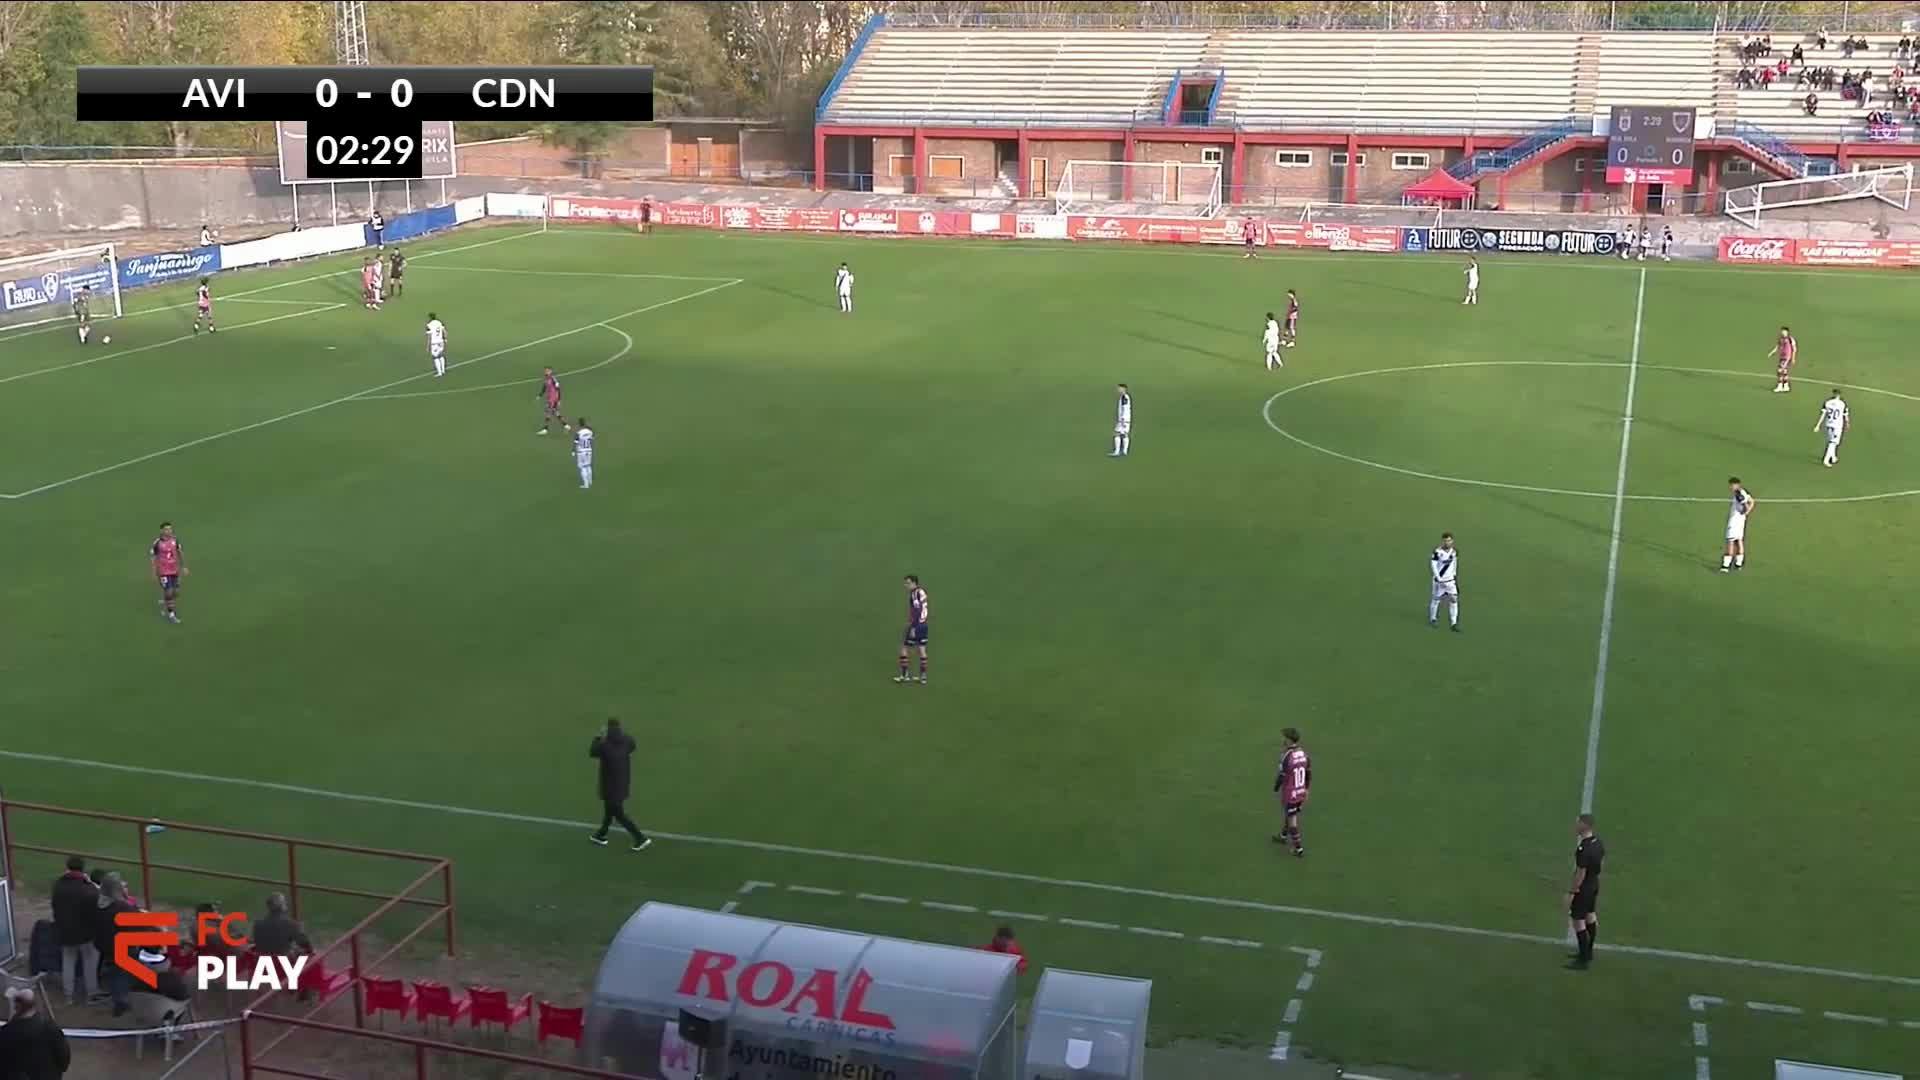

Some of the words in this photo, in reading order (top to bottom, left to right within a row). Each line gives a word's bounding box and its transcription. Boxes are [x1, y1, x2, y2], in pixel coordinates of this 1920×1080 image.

[1617, 147, 1628, 163] 0
[1672, 149, 1683, 165] 0
[1499, 231, 1544, 245] SEGUNDA
[1293, 766, 1306, 788] 10
[676, 948, 897, 1030] ROAL
[785, 1016, 896, 1047] CARNICAS
